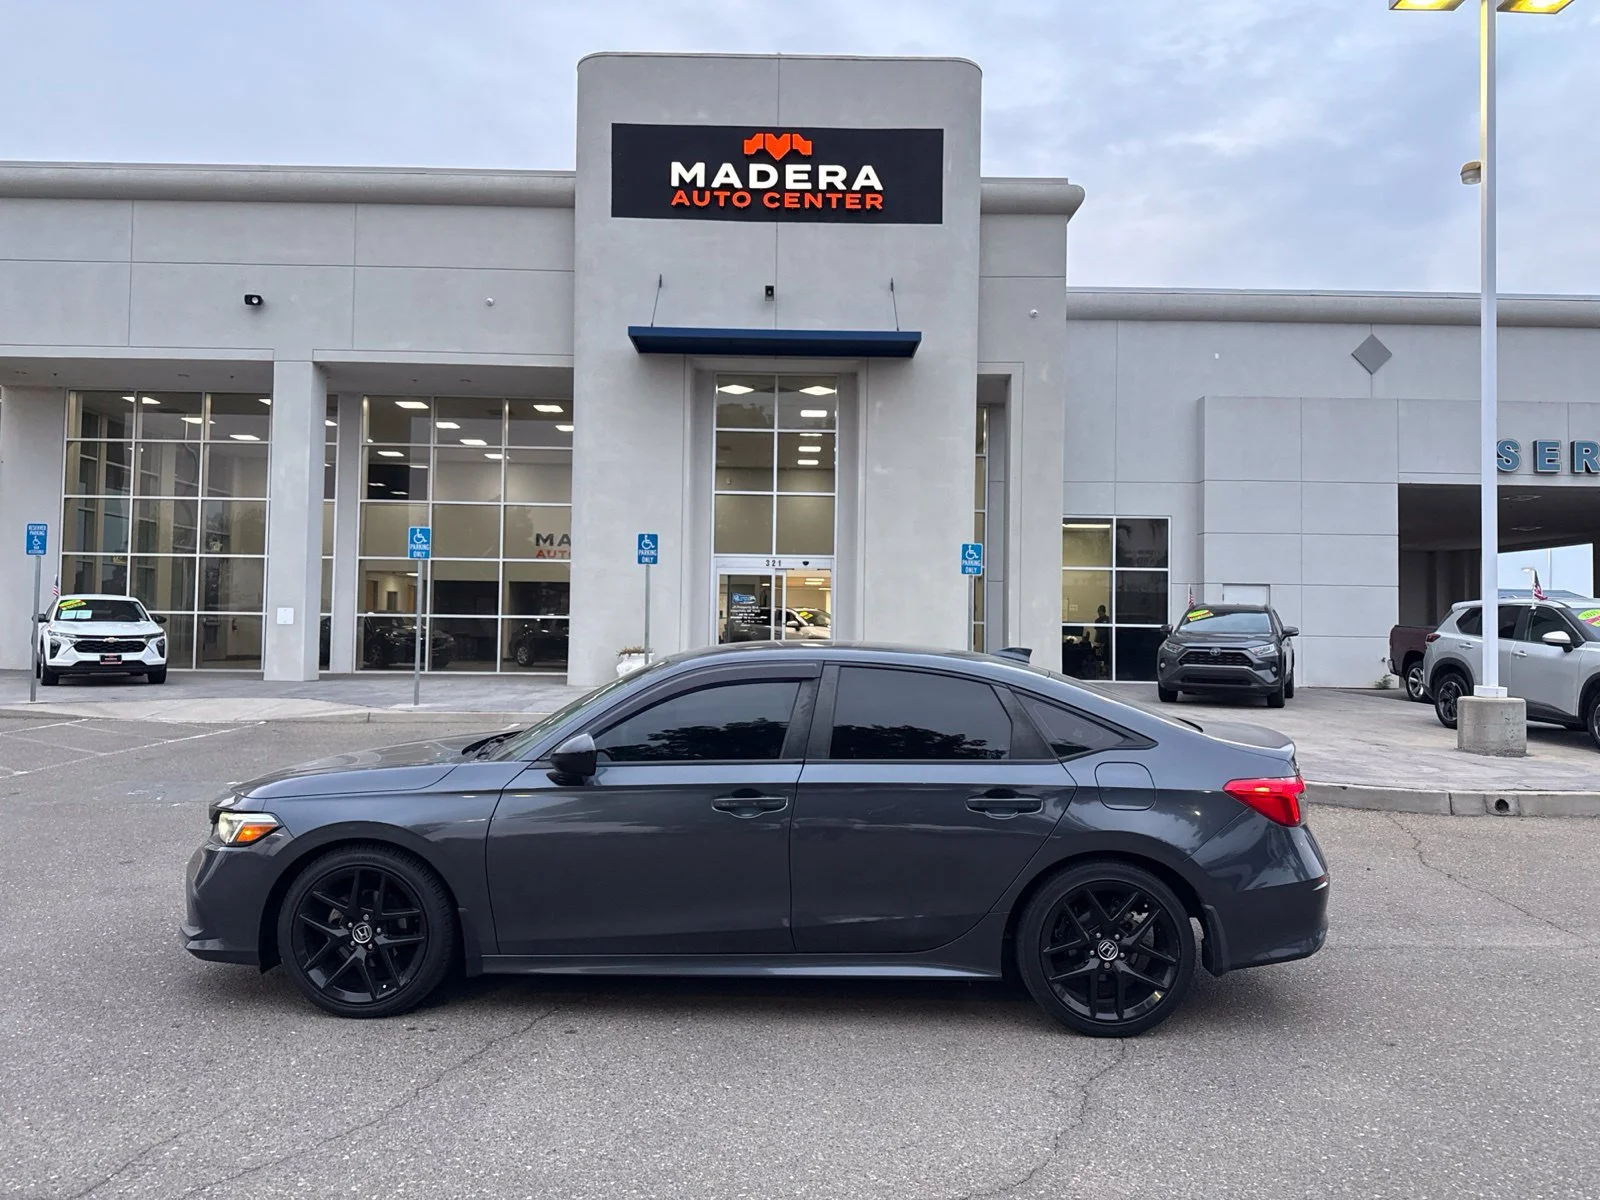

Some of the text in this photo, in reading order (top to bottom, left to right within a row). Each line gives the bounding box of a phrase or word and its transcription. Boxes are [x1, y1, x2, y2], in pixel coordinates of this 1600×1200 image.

[671, 161, 884, 191] MADERA
[671, 190, 884, 210] AUTO CENTER
[410, 543, 430, 551] PARKING
[413, 550, 426, 558] ONLY
[535, 550, 571, 559] AUT
[638, 549, 657, 557] PARKING
[641, 556, 654, 564] ONLY
[765, 559, 782, 567] 321
[962, 559, 981, 567] PARKING
[965, 566, 978, 574] ONLY
